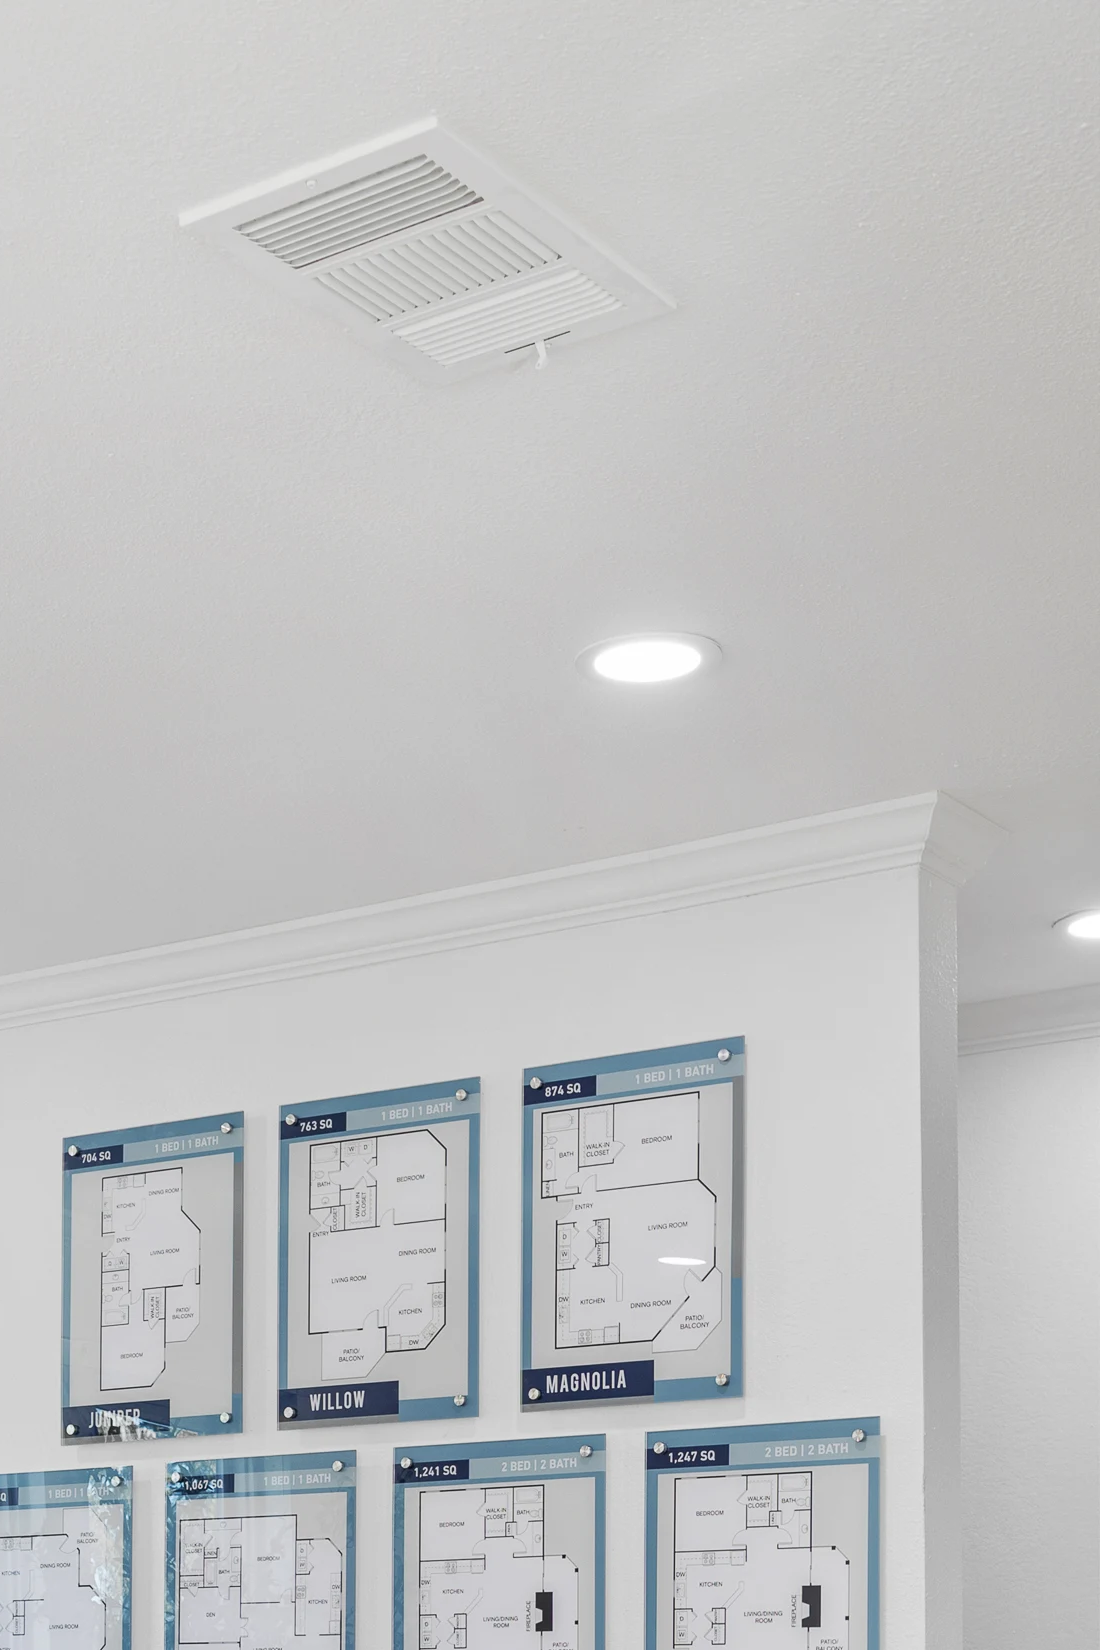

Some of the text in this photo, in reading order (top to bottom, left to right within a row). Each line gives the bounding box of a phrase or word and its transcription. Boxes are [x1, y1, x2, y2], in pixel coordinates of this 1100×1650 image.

[636, 1064, 714, 1084] 1 BED 1 BATH
[545, 1083, 581, 1097] 874 SQ
[382, 1102, 453, 1120] 1 BED 1 BATH
[300, 1119, 333, 1132] 763 SQ
[155, 1136, 219, 1153] 1 BED 1 BATH
[586, 1142, 610, 1150] WALK-IN
[641, 1135, 672, 1144] BEDROOM
[82, 1151, 111, 1163] 704 SQ
[397, 1174, 425, 1183] BEDROOM
[546, 1370, 626, 1394] MAGNOLIA
[309, 1390, 365, 1411] WILLOW
[765, 1443, 849, 1457] 2 BED 2 BATH
[668, 1450, 715, 1464] 1,247 SQ
[502, 1458, 577, 1471] 2 BED 2 BATH
[414, 1465, 457, 1478] 1,241 SQ
[185, 1480, 223, 1491] 1,067 SQ
[264, 1473, 331, 1486] 1 BED 1 BATH
[55, 1487, 71, 1498] BED
[80, 1488, 84, 1496] 1
